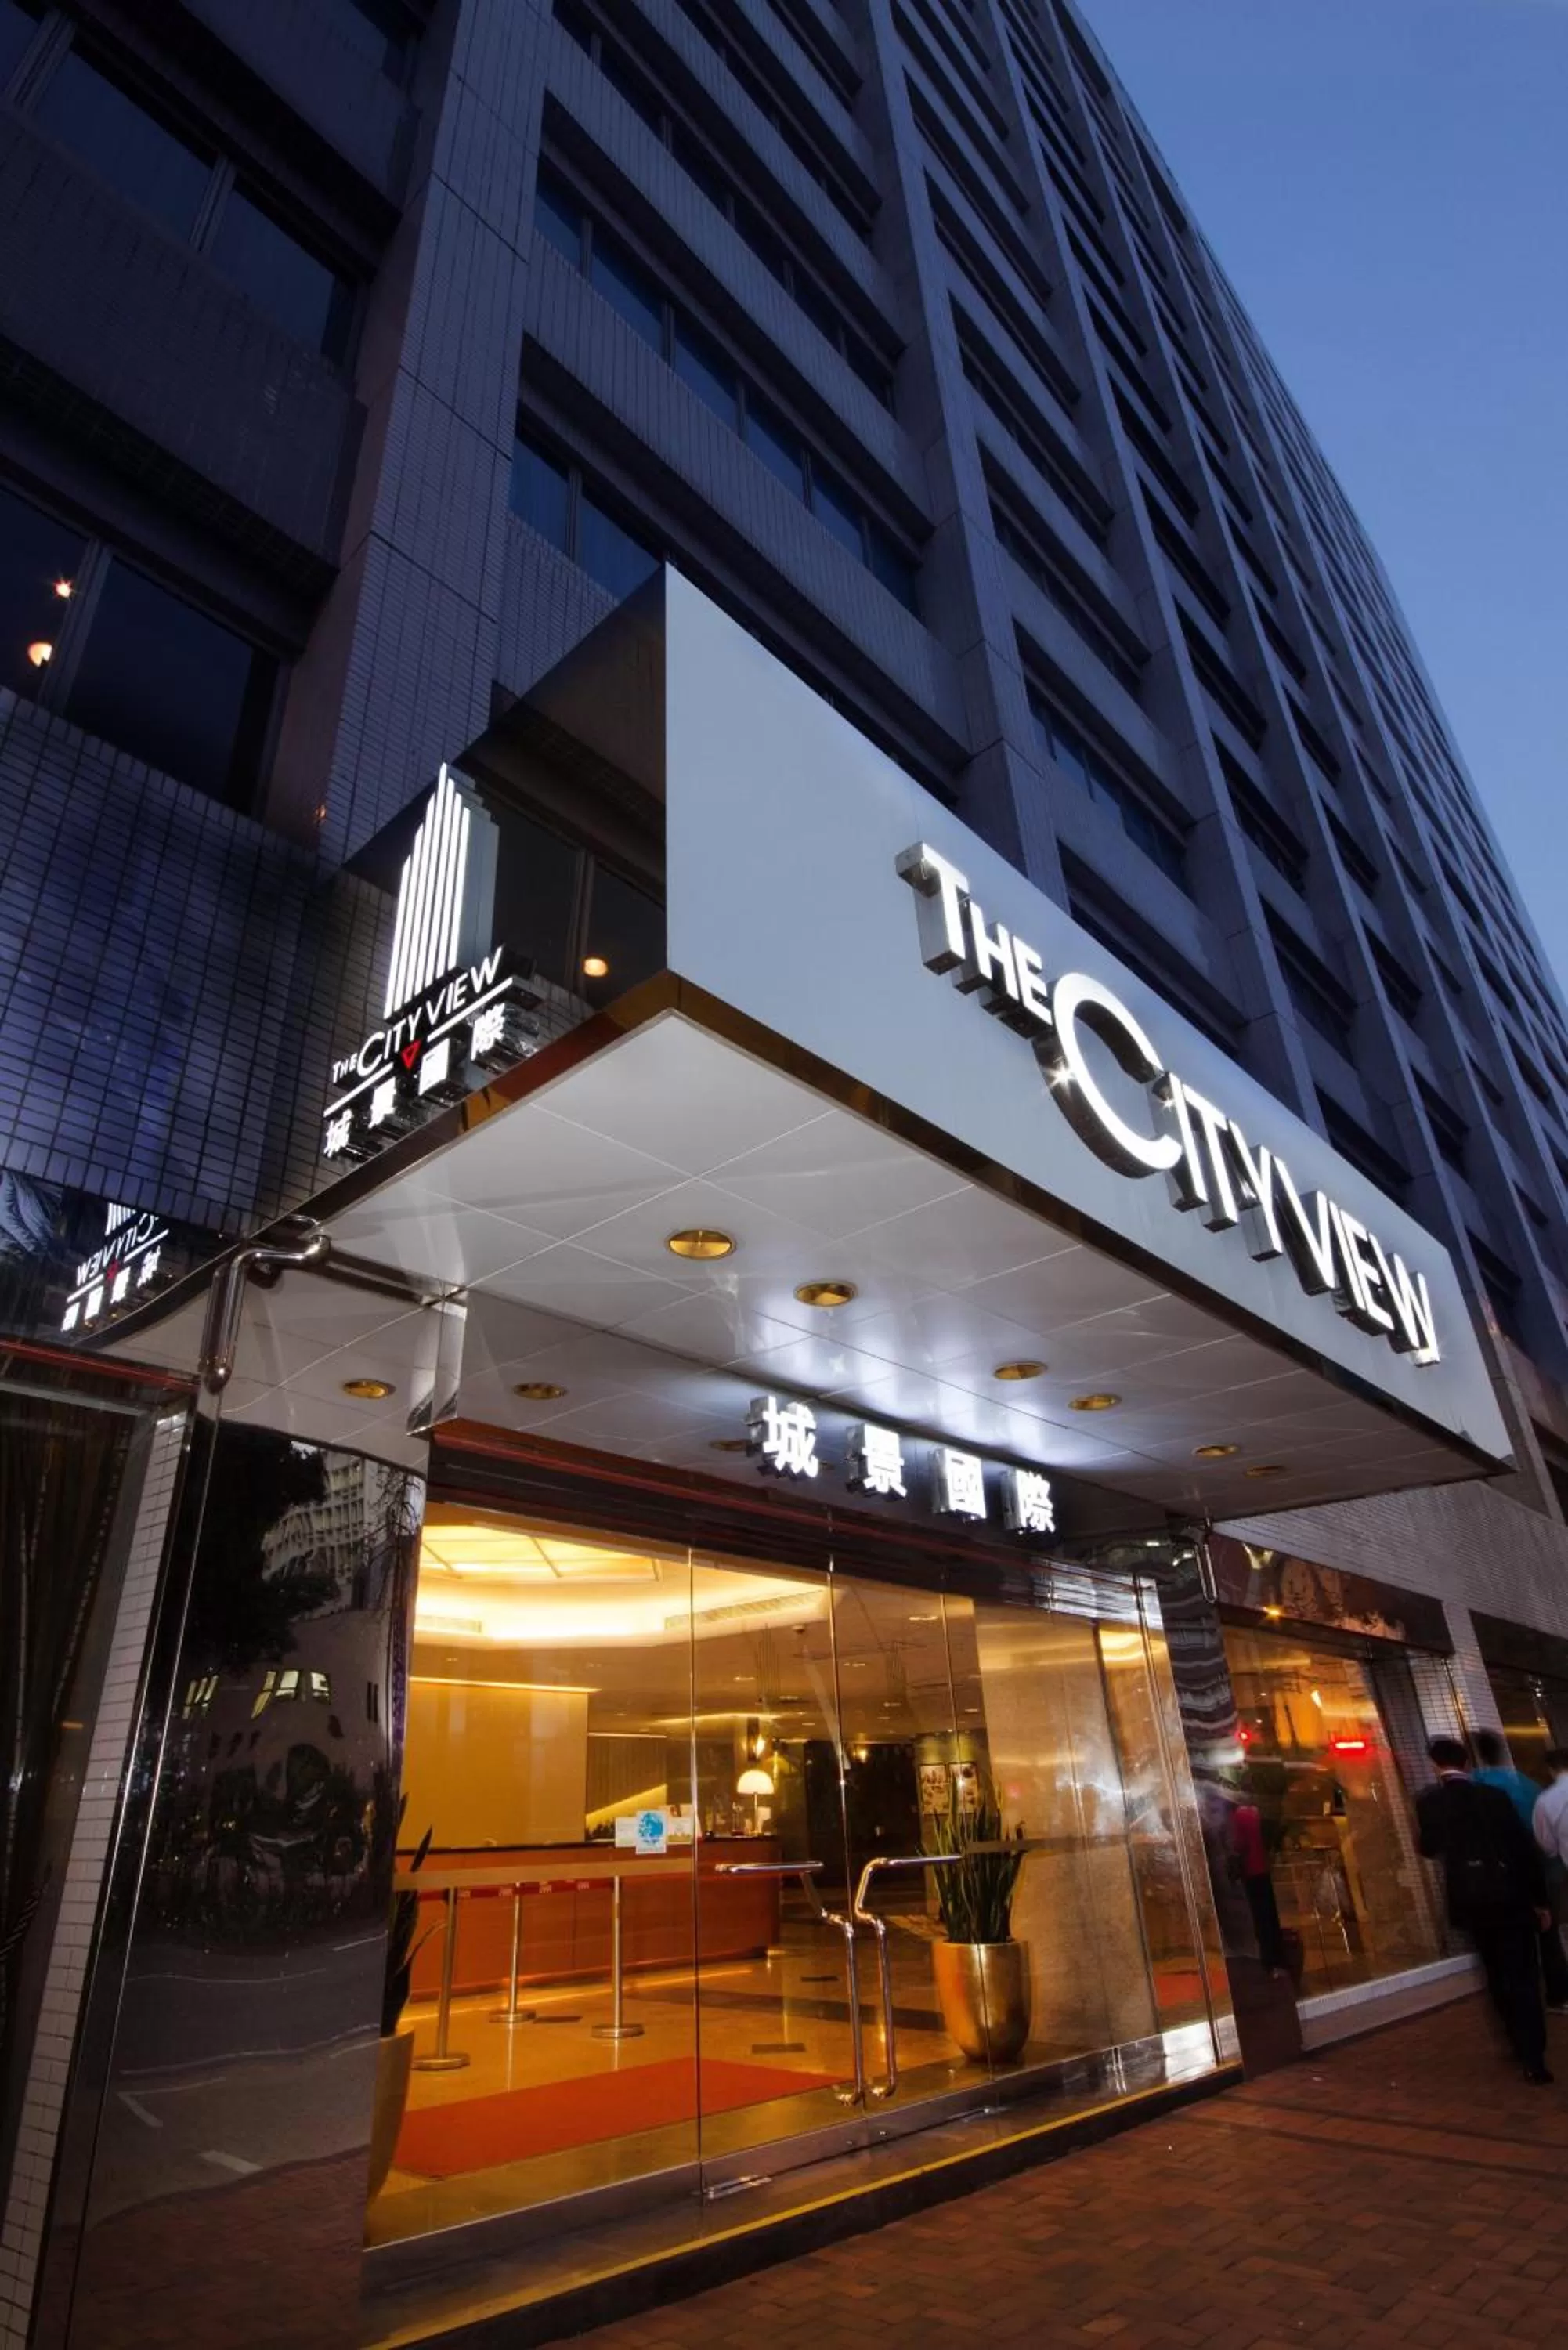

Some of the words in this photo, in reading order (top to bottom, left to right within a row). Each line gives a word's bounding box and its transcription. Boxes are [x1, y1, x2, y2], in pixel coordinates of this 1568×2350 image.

[920, 842, 1053, 1025] THE
[332, 1053, 357, 1084] THE
[763, 1396, 1055, 1533] 城景國際
